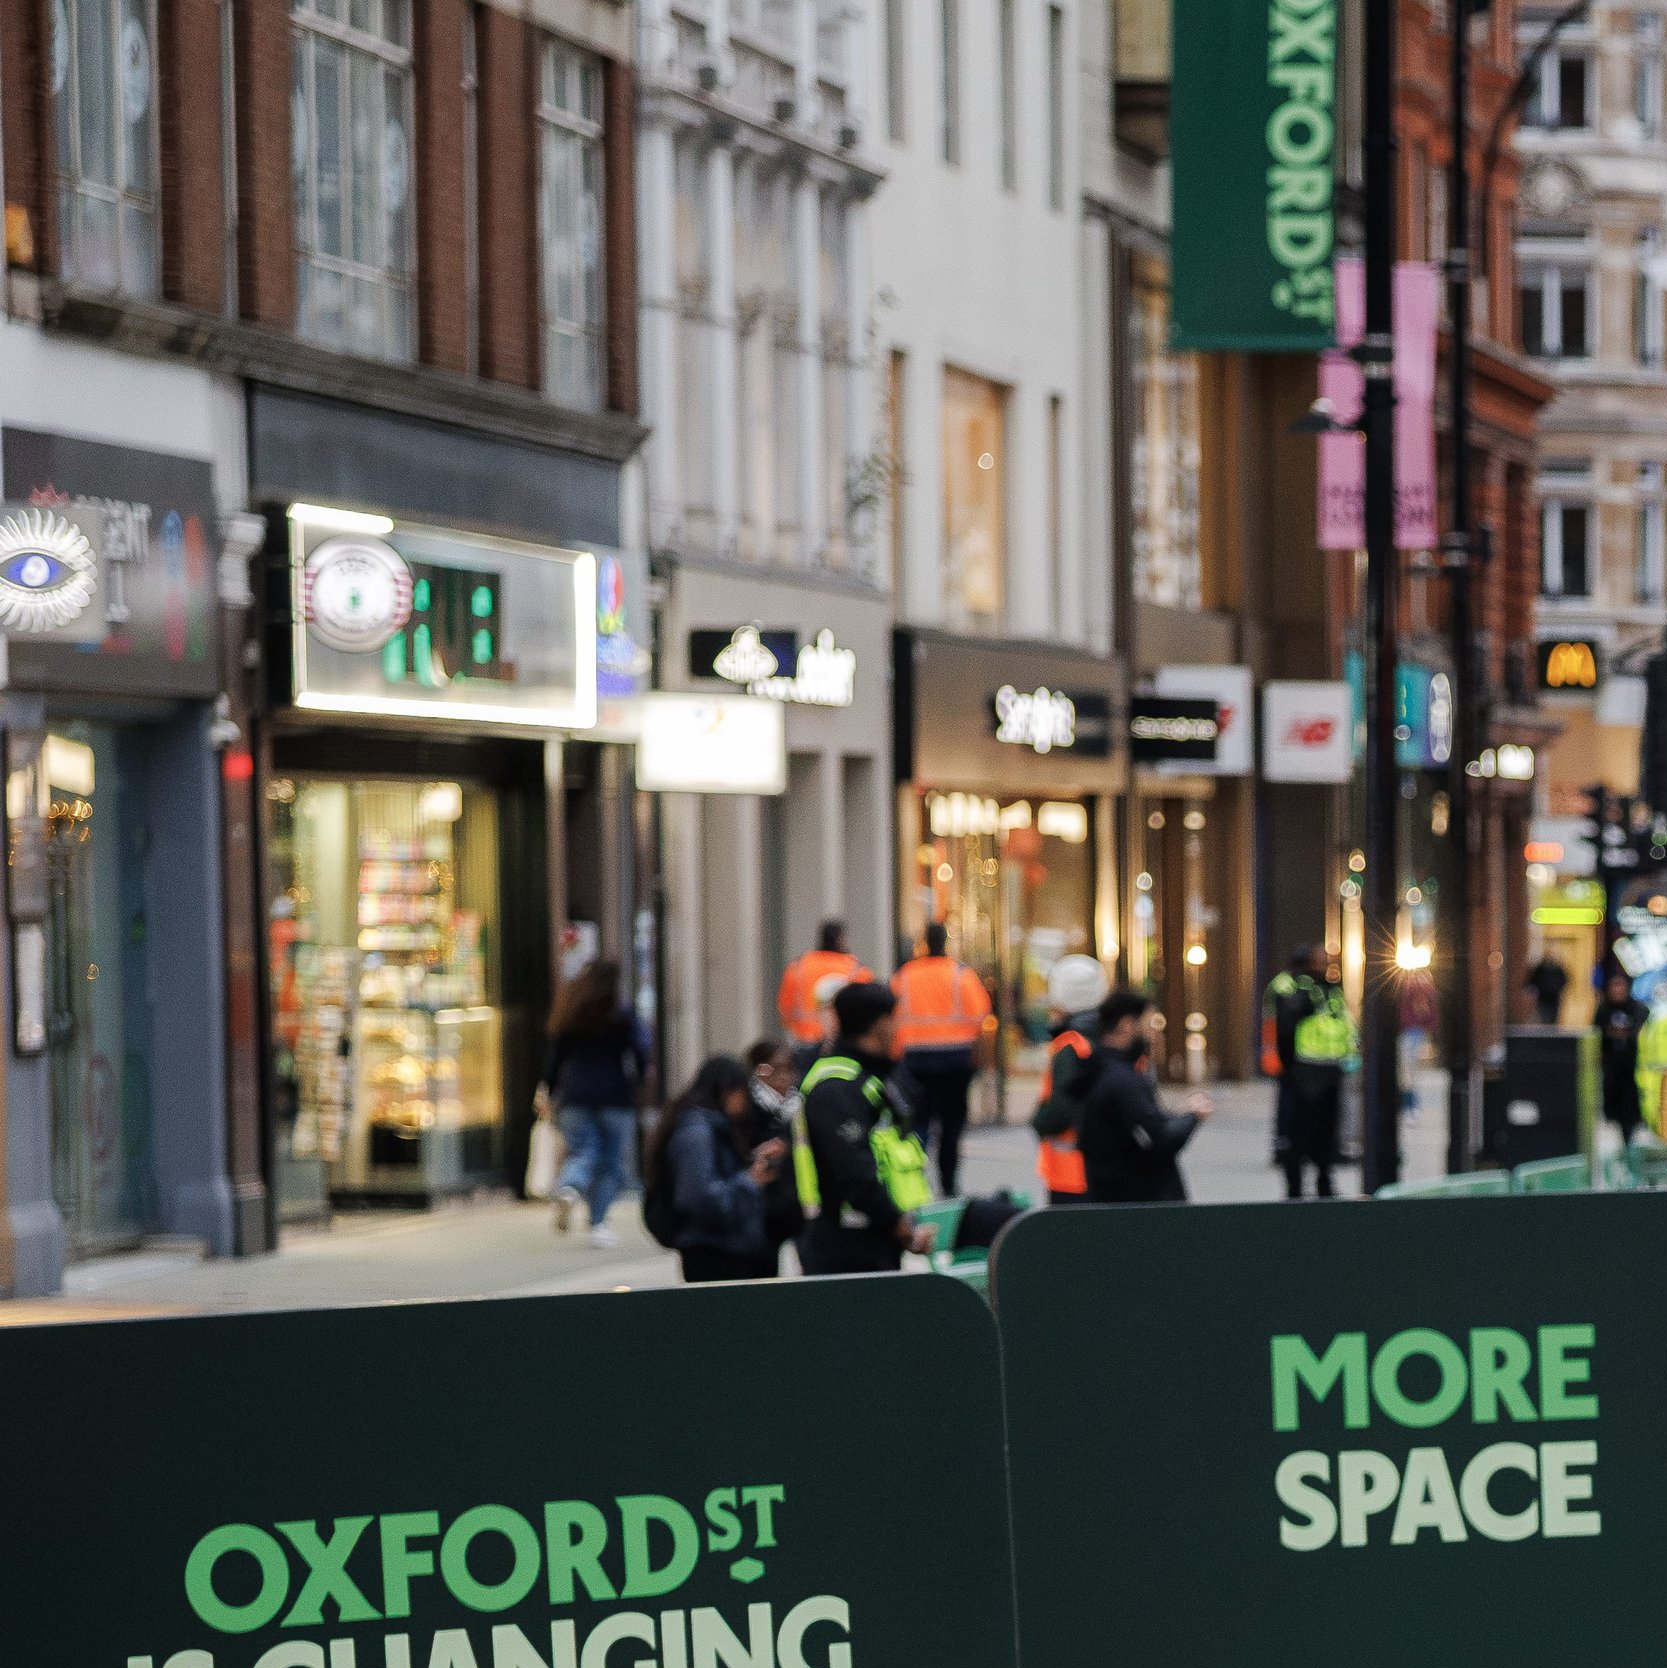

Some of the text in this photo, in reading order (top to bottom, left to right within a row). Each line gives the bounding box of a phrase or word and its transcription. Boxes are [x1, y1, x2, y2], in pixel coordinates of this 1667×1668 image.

[1265, 0, 1335, 268] XFORD
[1271, 1323, 1599, 1431] MORE
[1275, 1440, 1601, 1551] SPACE
